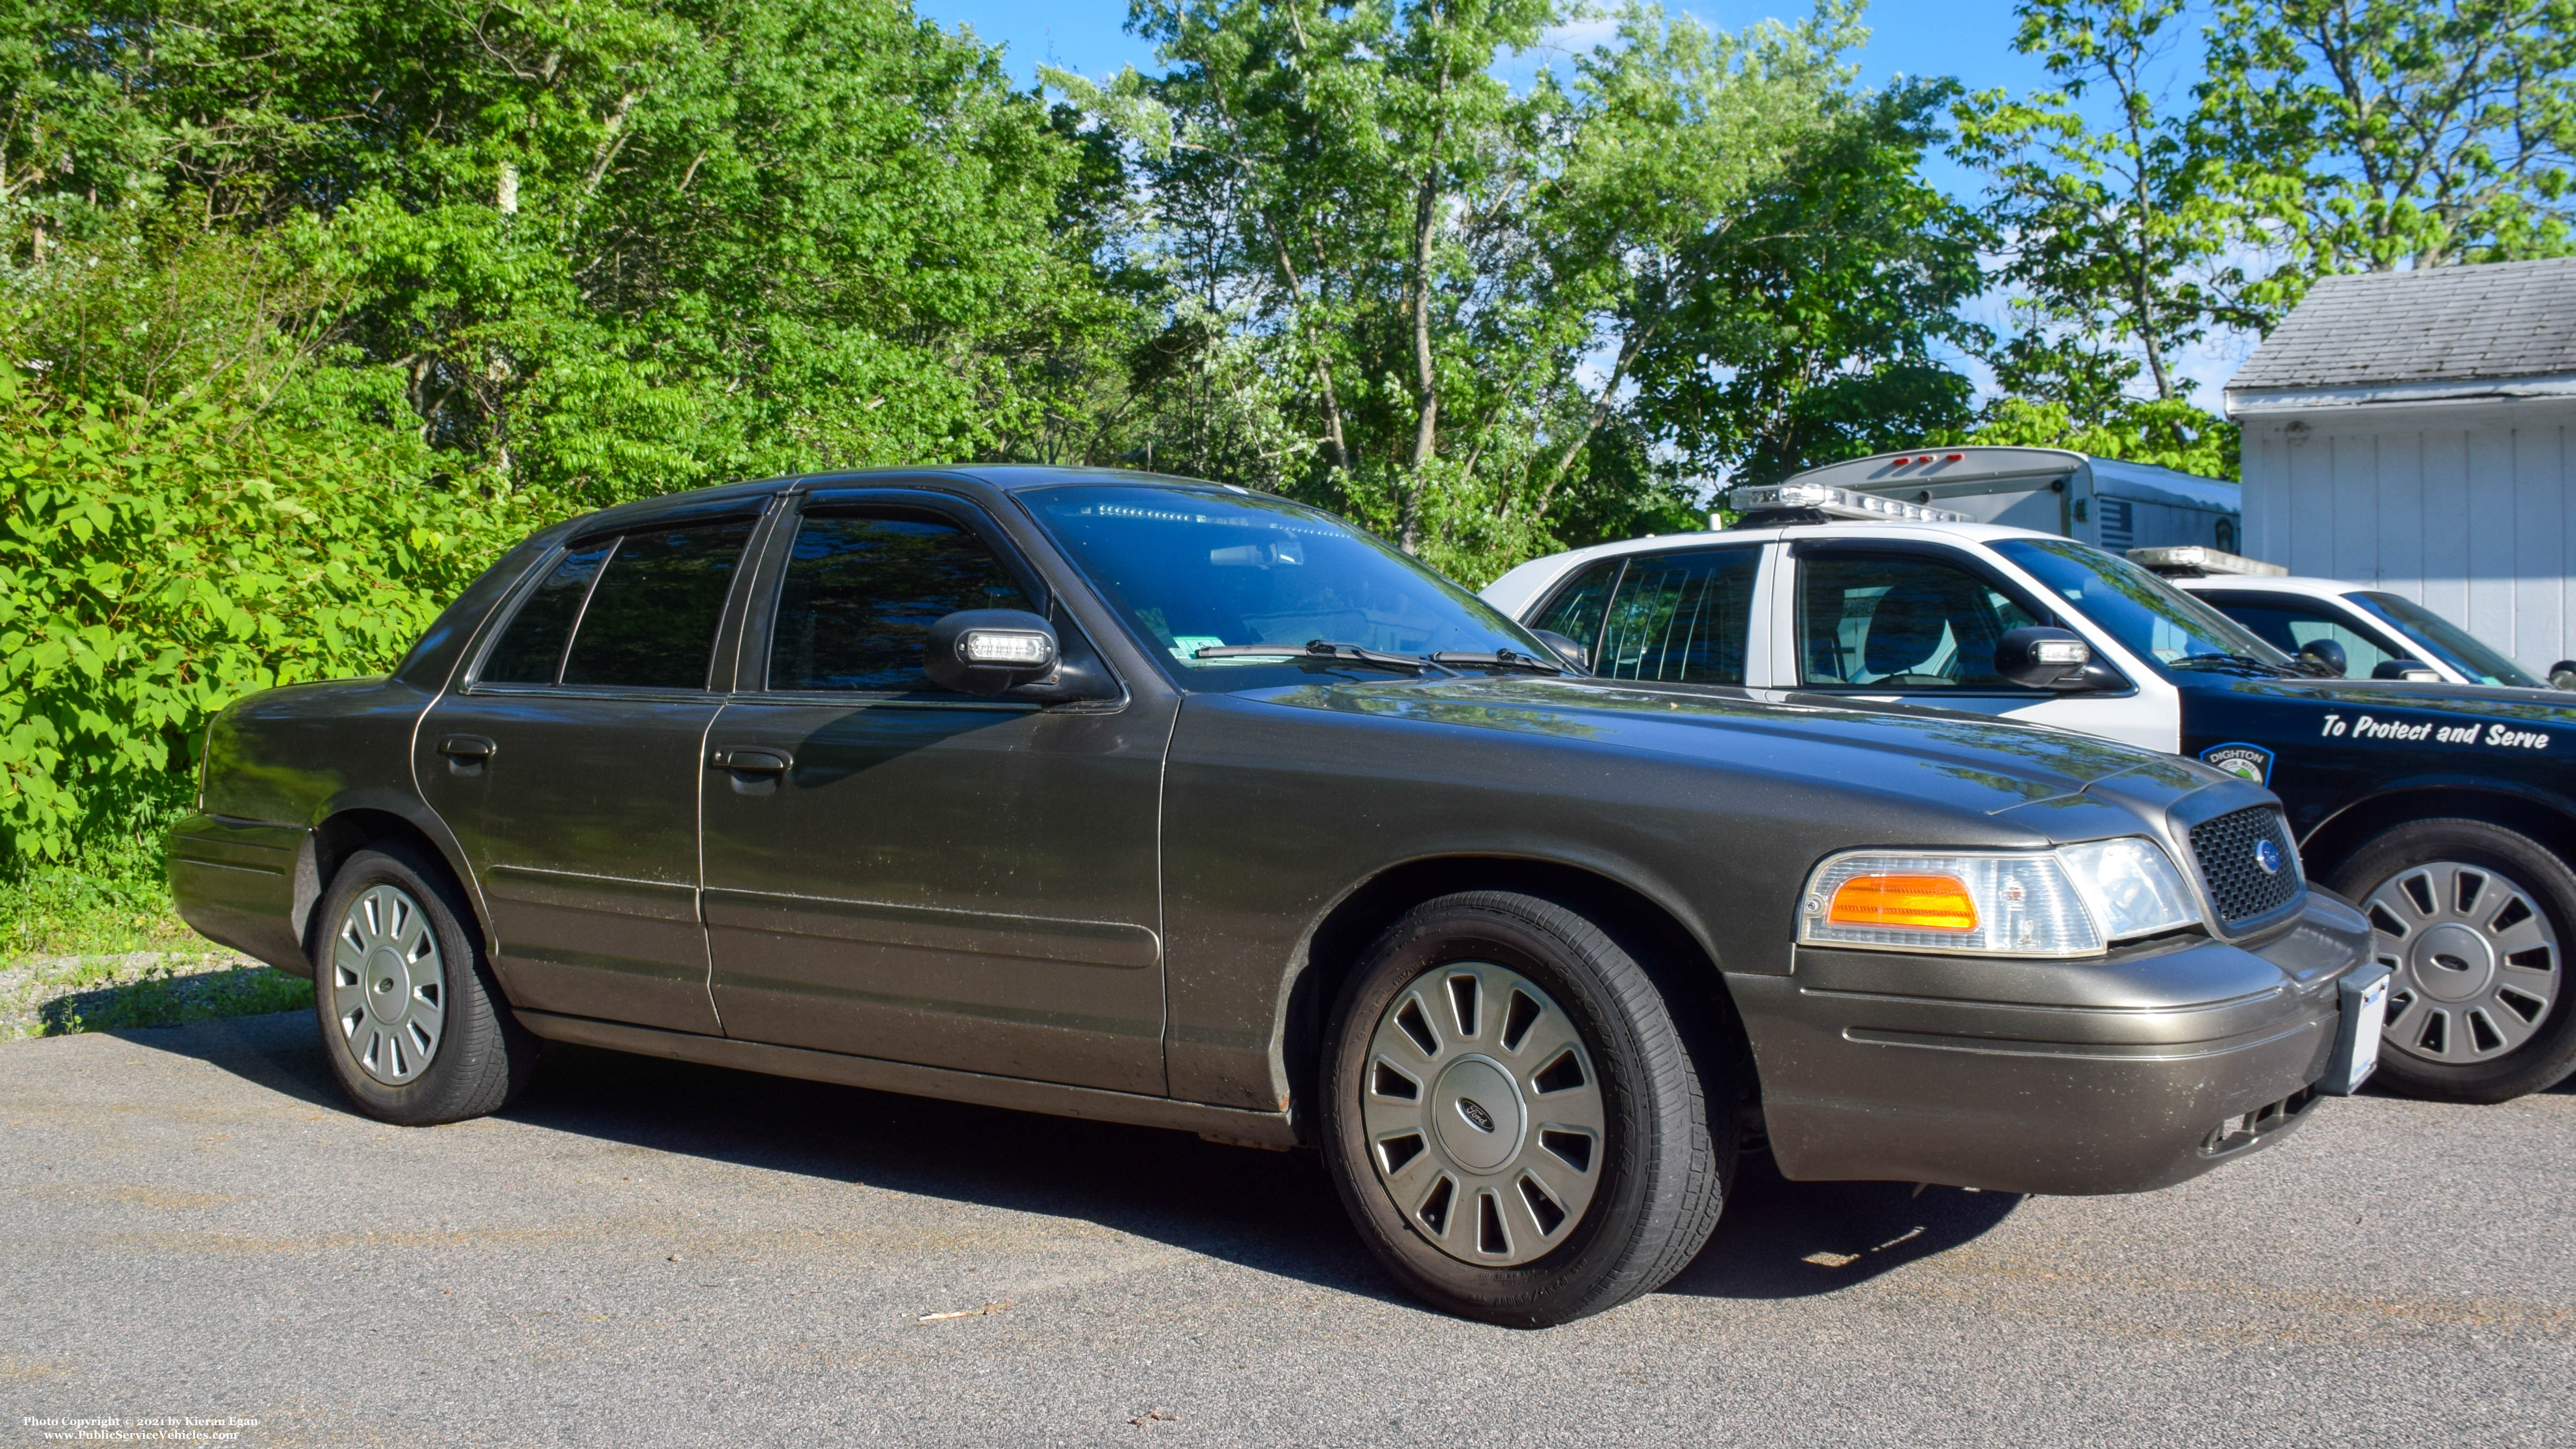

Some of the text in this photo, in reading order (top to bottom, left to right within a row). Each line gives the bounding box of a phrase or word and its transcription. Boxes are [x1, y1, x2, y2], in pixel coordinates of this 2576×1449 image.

[2322, 714, 2549, 749] To Protect and Serve
[2209, 750, 2264, 764] DIGHTON
[1548, 959, 1635, 1176] GOODYEAR
[1466, 1105, 1487, 1125] Ford
